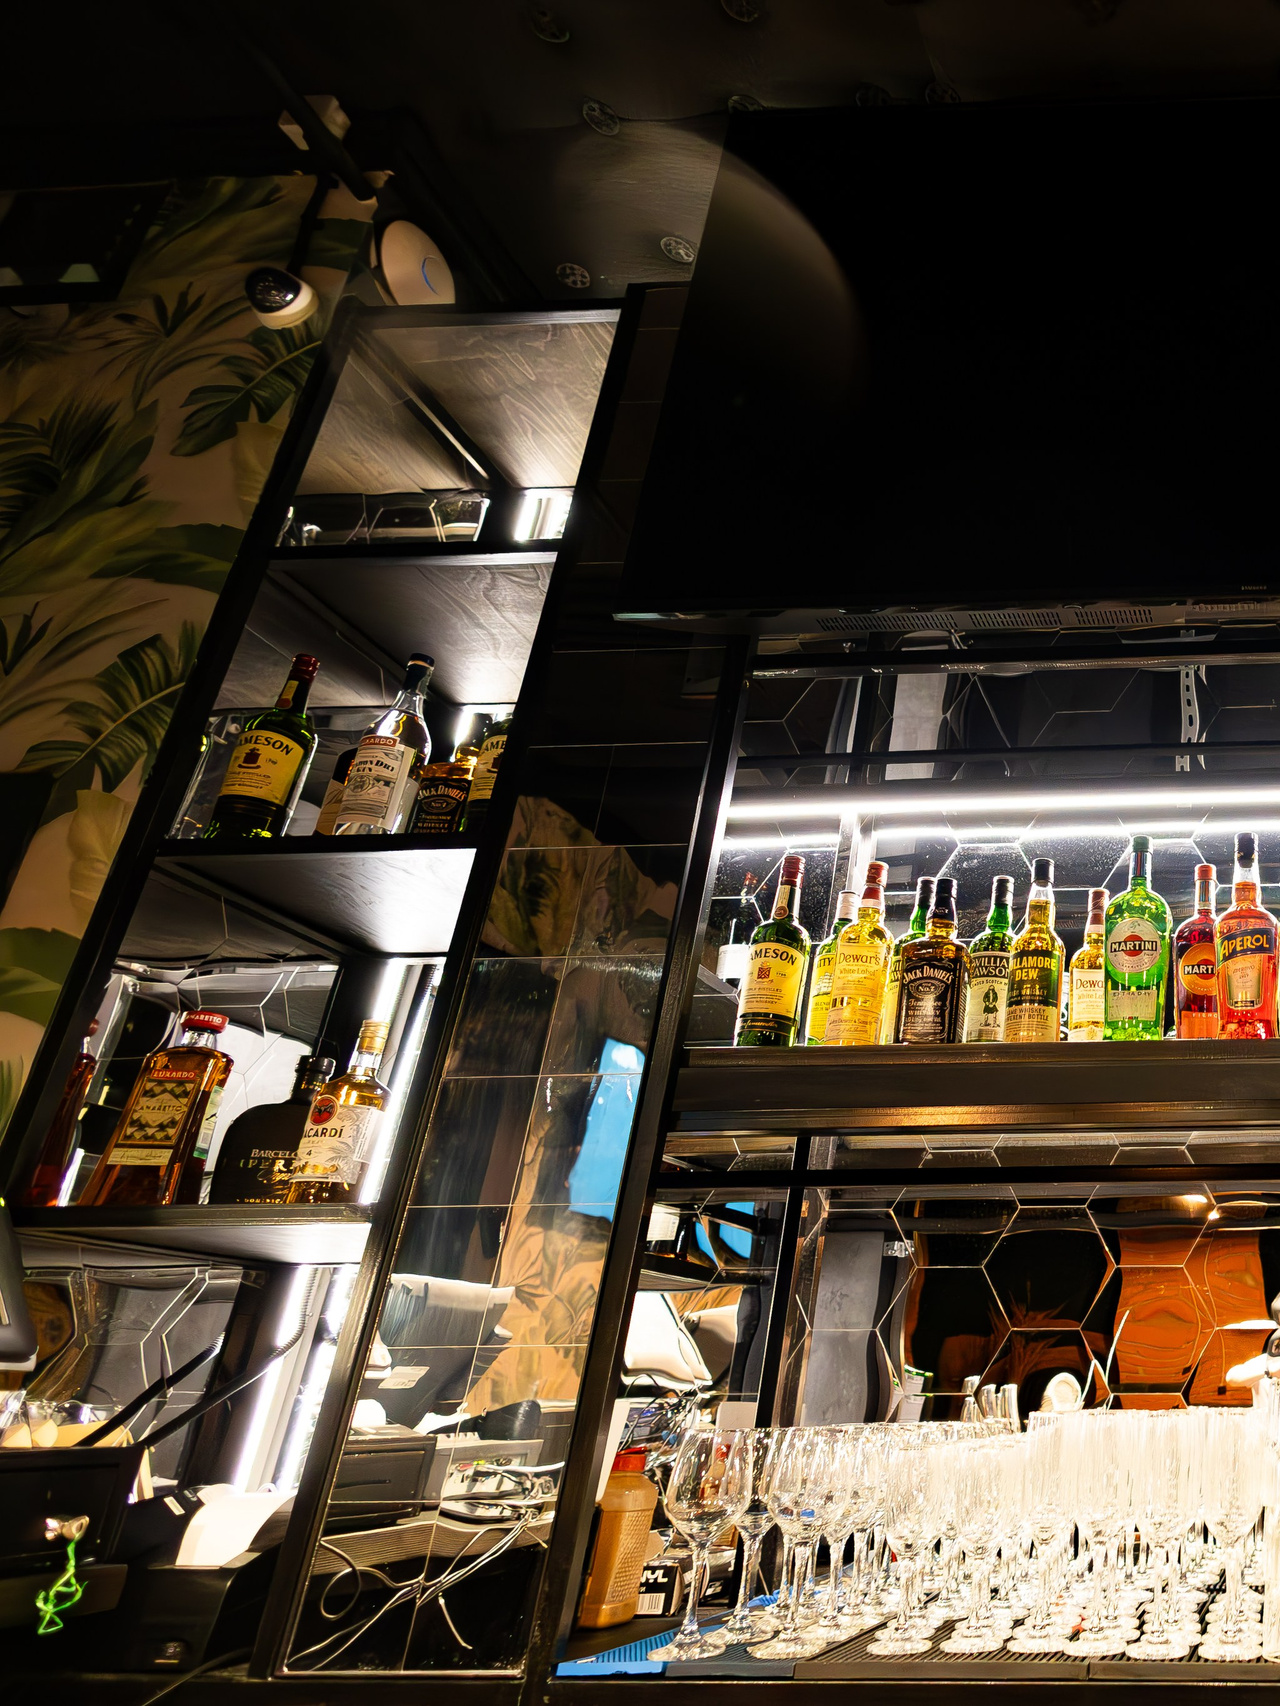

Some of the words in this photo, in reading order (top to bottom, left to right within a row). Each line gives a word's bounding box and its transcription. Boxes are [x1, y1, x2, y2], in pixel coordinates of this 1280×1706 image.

[1111, 941, 1156, 952] MARTINI
[1220, 934, 1269, 961] APEROL
[838, 952, 880, 966] Dewar's
[903, 969, 922, 984] JACK
[923, 965, 954, 984] DANIEL'S
[186, 1013, 222, 1024] AMARETTO
[1028, 1013, 1049, 1021] BOTTLE
